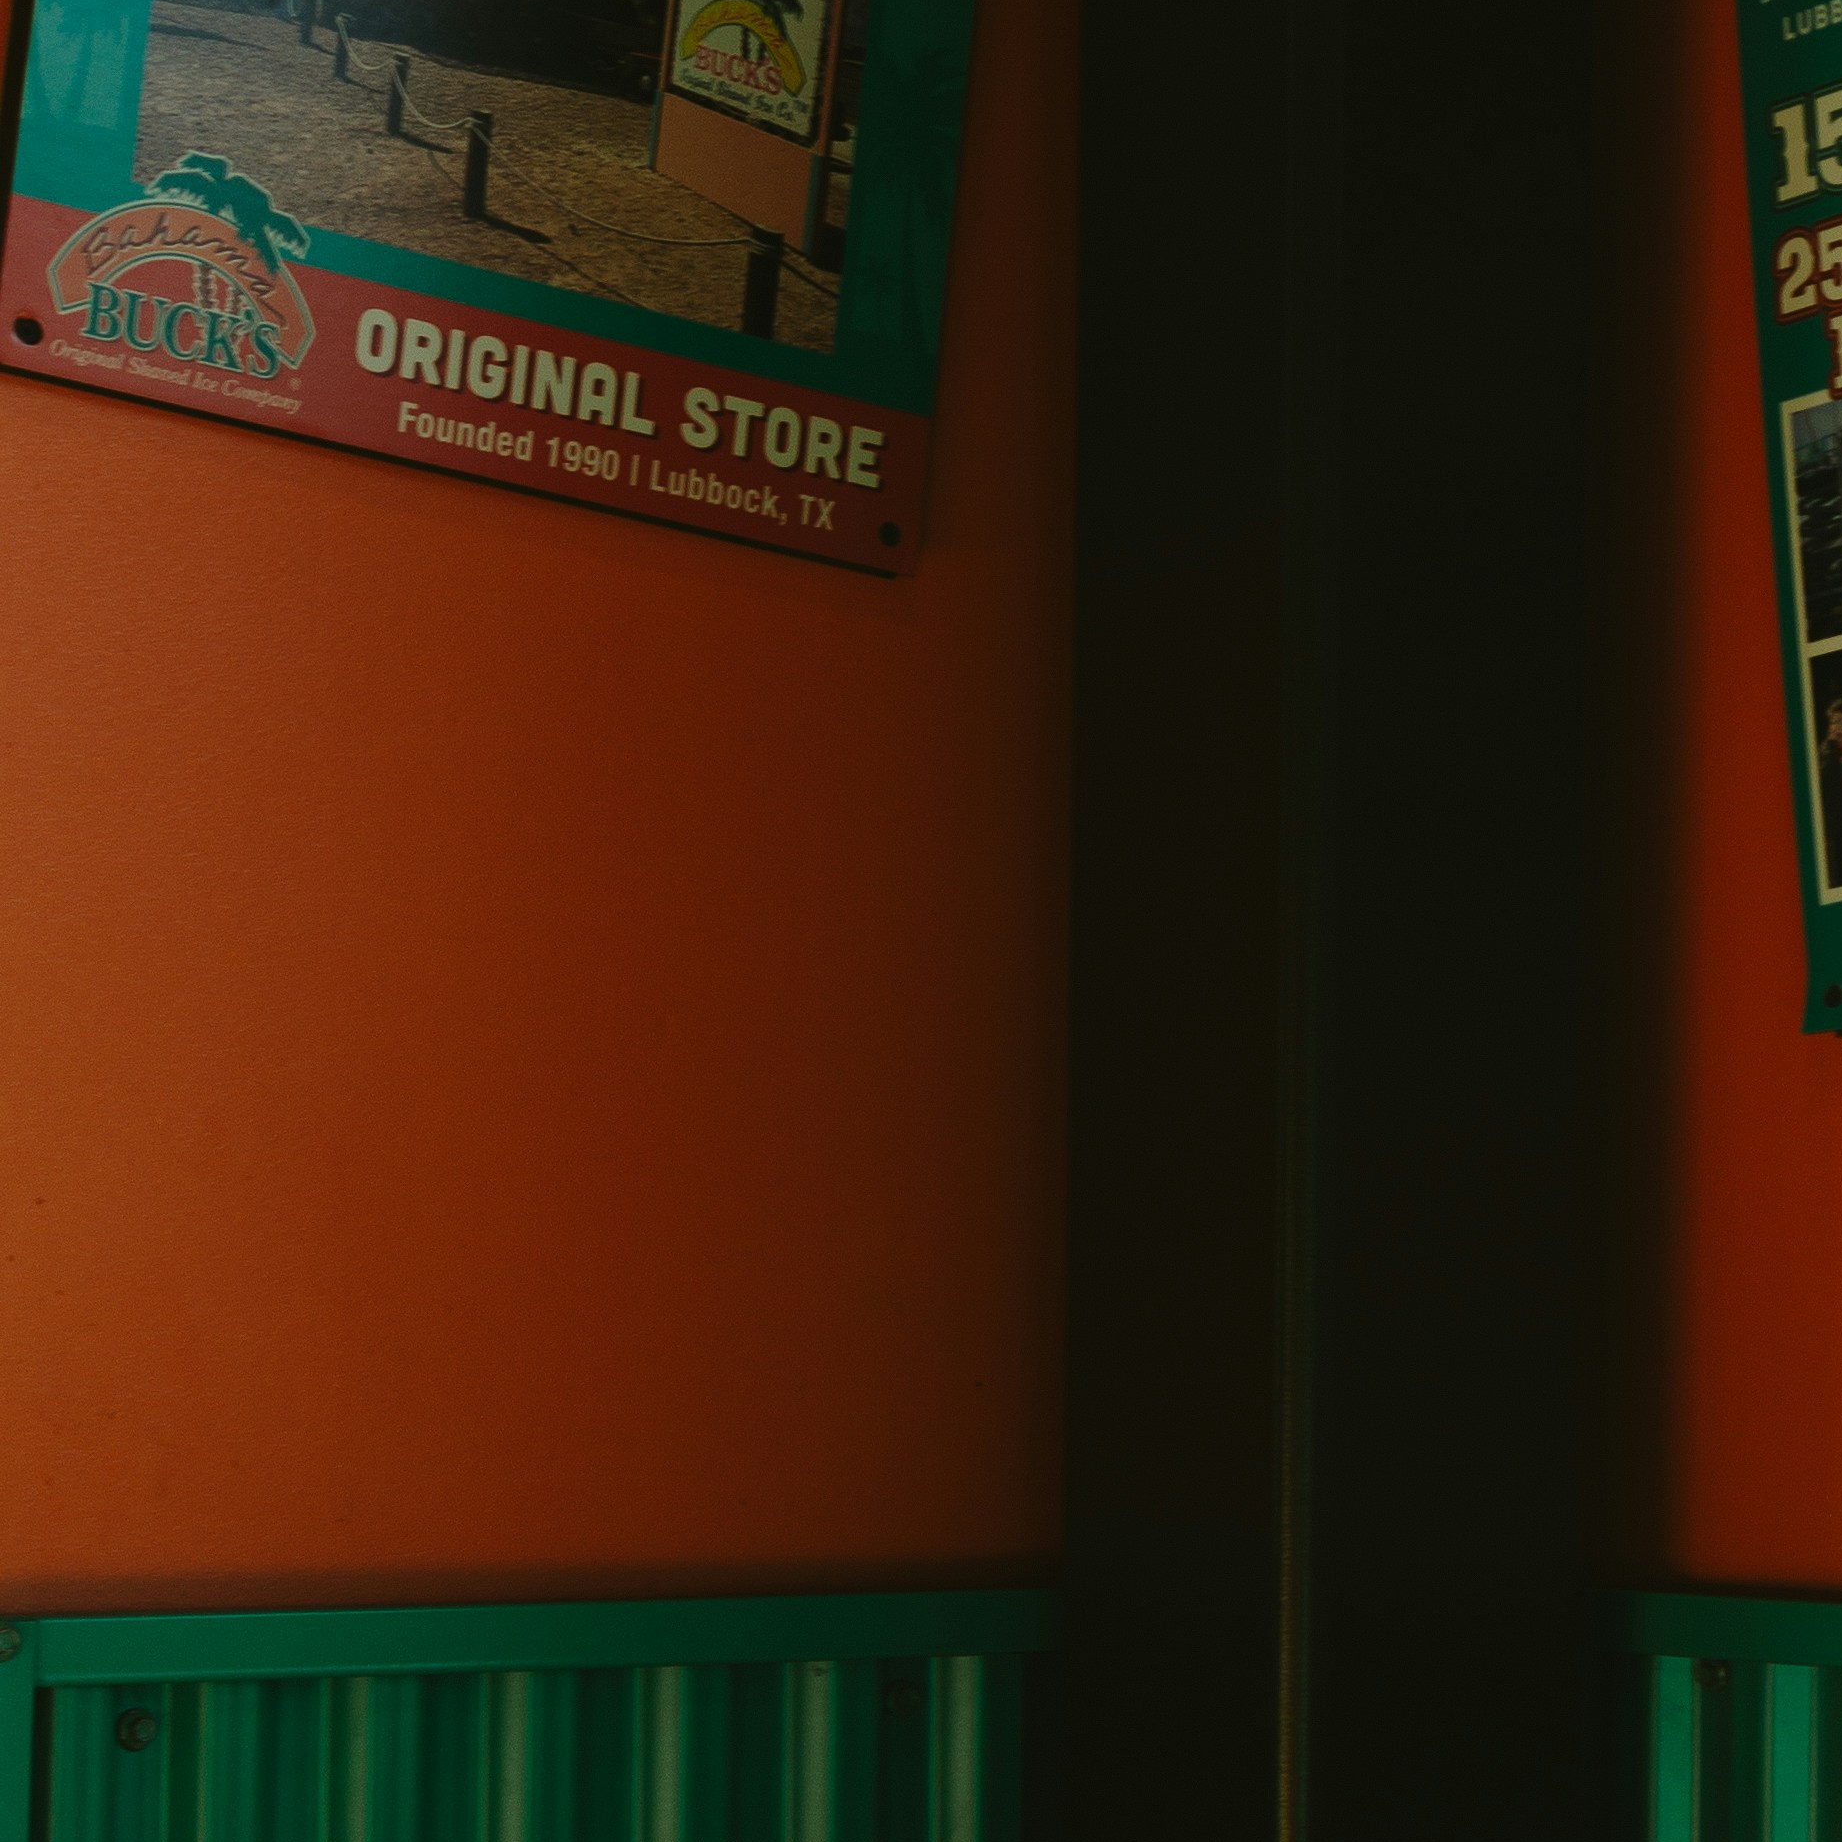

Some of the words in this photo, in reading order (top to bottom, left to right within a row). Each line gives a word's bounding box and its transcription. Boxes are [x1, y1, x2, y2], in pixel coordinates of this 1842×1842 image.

[81, 282, 281, 379] BUCK'S
[192, 371, 218, 394] Ice
[355, 308, 657, 438] ORIGINAL
[679, 387, 887, 490] STORE
[396, 400, 535, 461] Founded
[545, 437, 620, 482] 1990
[648, 460, 789, 526] Lubbock,
[797, 493, 837, 531] TX
